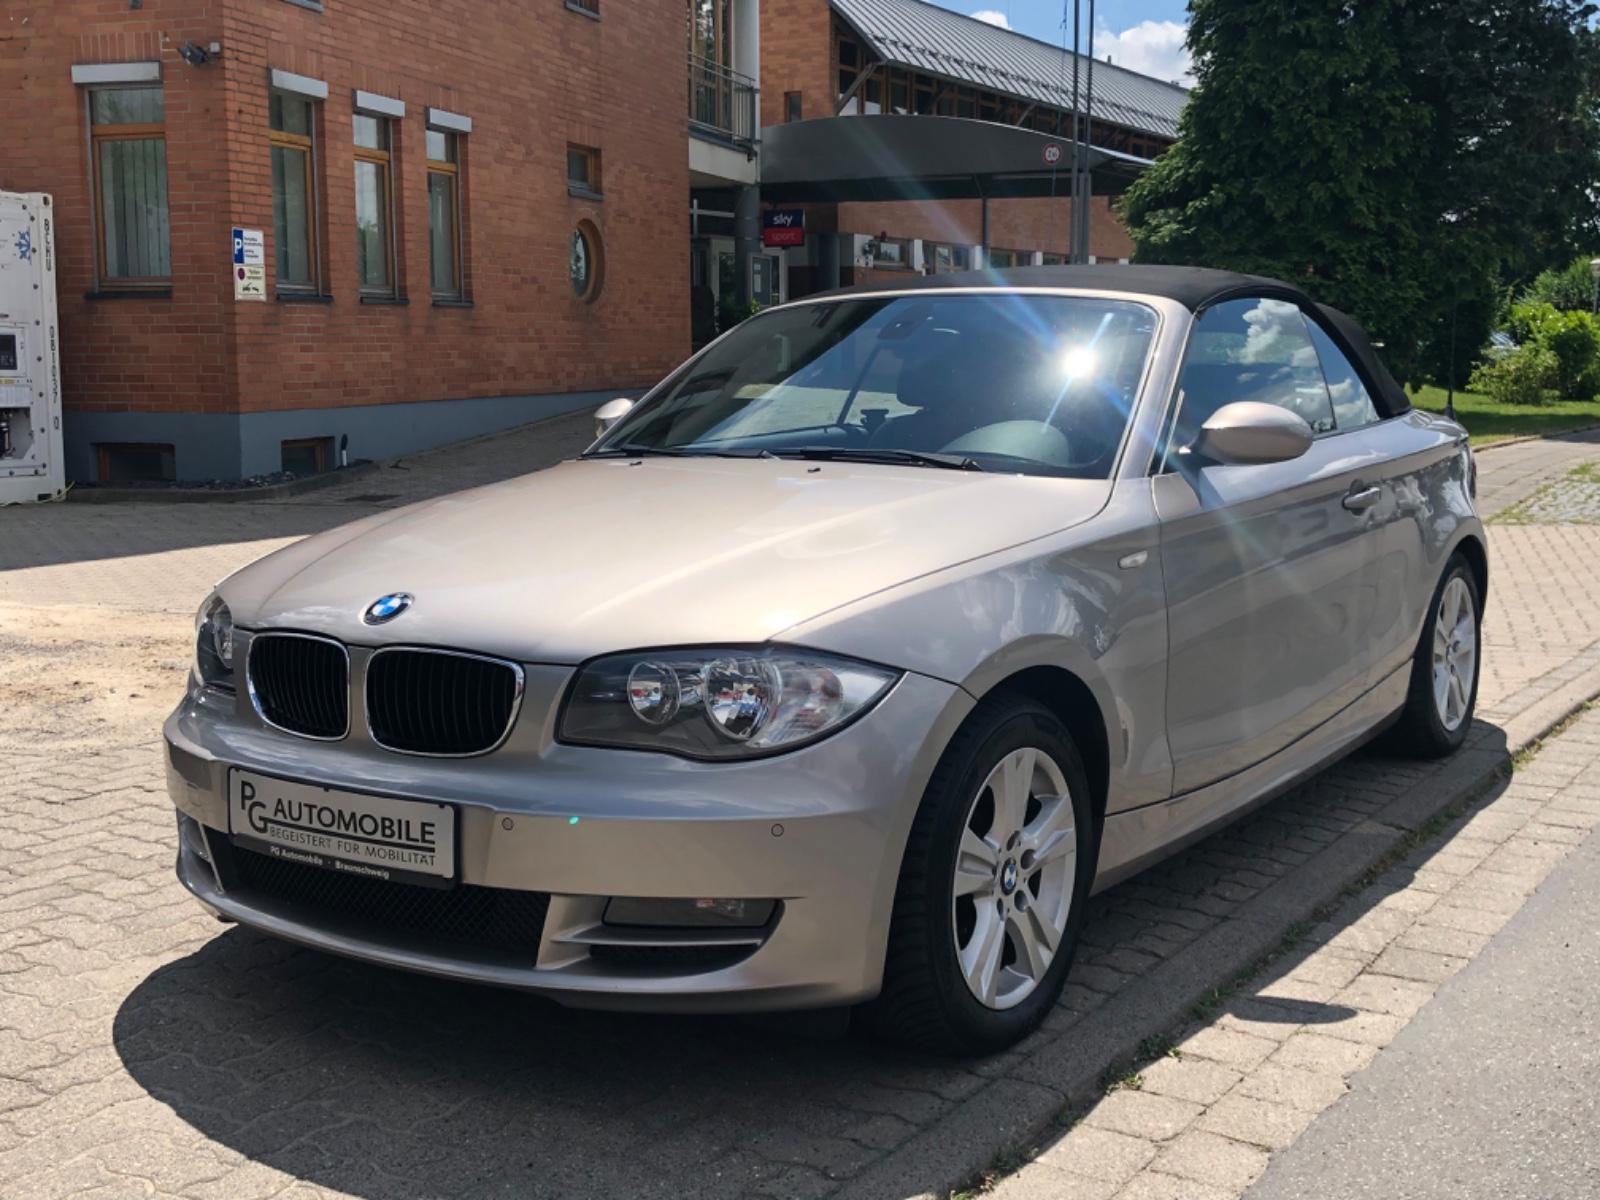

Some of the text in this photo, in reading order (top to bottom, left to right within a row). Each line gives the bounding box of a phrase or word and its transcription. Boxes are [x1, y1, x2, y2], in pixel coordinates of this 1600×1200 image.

[773, 212, 793, 227] sky
[235, 238, 242, 254] P
[274, 798, 436, 845] AUTOMOBILE
[269, 825, 437, 867] BEGEISTERT FÜR MOBILITÄT
[335, 860, 390, 880] Braunschweig
